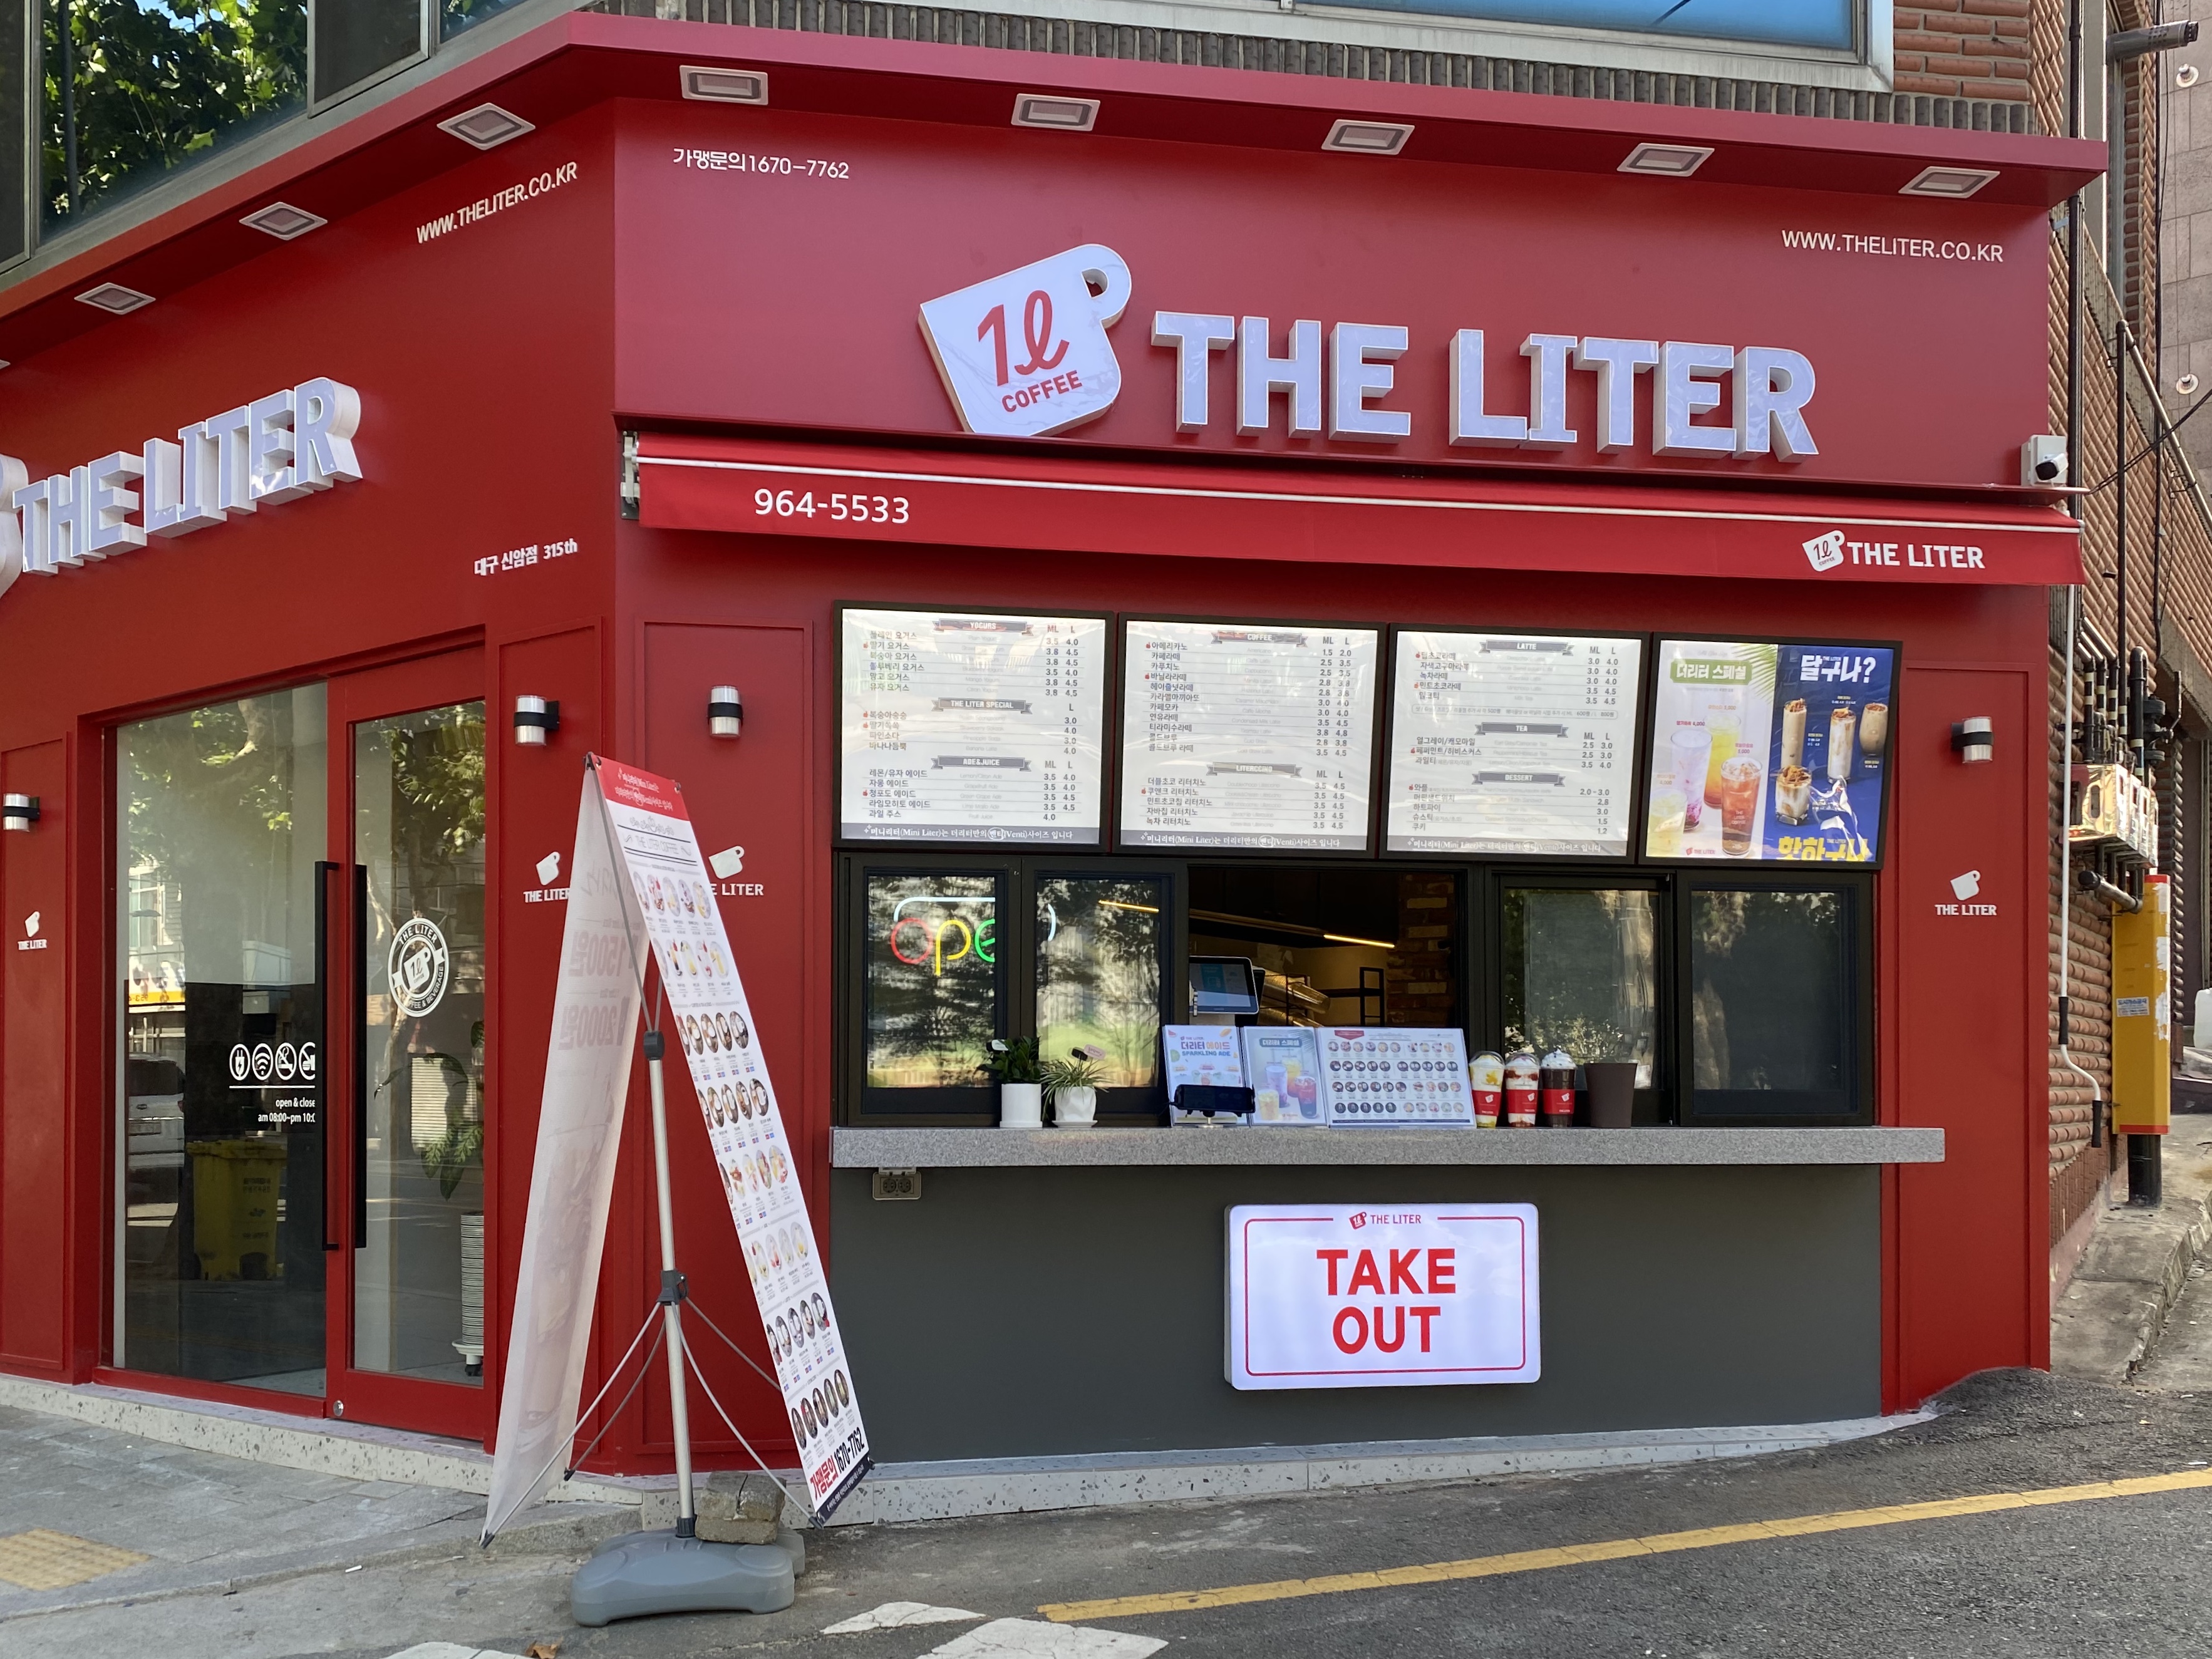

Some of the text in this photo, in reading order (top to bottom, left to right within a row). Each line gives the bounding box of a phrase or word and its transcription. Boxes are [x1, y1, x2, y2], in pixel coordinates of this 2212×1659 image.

[416, 162, 577, 244] WWW.THELITER.CO.KR
[1782, 229, 2004, 263] WWW.THELITER.CO.KR
[1001, 370, 1083, 413] COFFEE
[1152, 311, 1819, 464] THE LITER
[12, 376, 363, 576] THE LITER
[753, 488, 910, 524] 964-5533
[474, 538, 578, 576] 대구 신암점 315th
[1846, 542, 1986, 569] THE LITER
[970, 622, 996, 630] YOGURS
[1066, 638, 1078, 646] 4.0
[1247, 633, 1273, 641] COFFEE
[887, 642, 910, 650] 요거스
[895, 653, 917, 661] 요거스
[902, 663, 925, 671] 요거스
[1150, 662, 1180, 671] 카푸치노
[1800, 654, 1876, 683] 달구나?
[1676, 664, 1747, 680] 더리터 스페셜
[951, 700, 1014, 709] THE LITER SPECIAL
[1149, 723, 1192, 732] 티라미수라떼
[869, 731, 900, 740] 파인소다
[869, 768, 928, 778] 레몬/유자 에이드
[886, 780, 909, 788] 에이드
[1178, 778, 1207, 787] 리터치노
[894, 790, 917, 798] 에이드
[1171, 788, 1199, 797] 리터치노
[869, 799, 931, 809] 라임모히토 에이드
[1184, 798, 1212, 807] 리터치노
[869, 810, 902, 818] 과일 주스
[1147, 807, 1198, 817] 자바칩 리터치노
[1162, 817, 1191, 826] 리터치노
[1412, 823, 1426, 831] 쿠키
[721, 883, 764, 896] LITER
[522, 889, 542, 903] THE
[1934, 904, 1997, 916] THE LITER
[398, 924, 438, 946] THE LITER
[426, 966, 444, 1005] BEVERAGE
[1181, 1041, 1205, 1050] 더리터
[276, 1099, 292, 1110] open
[293, 1097, 299, 1107] &
[258, 1114, 268, 1122] am
[1370, 1214, 1422, 1224] THE LITER
[1316, 1248, 1457, 1296] TAKE
[1332, 1306, 1441, 1355] OUT
[810, 1454, 839, 1501] 가맹문의
[834, 1427, 865, 1474] 1670-7762
